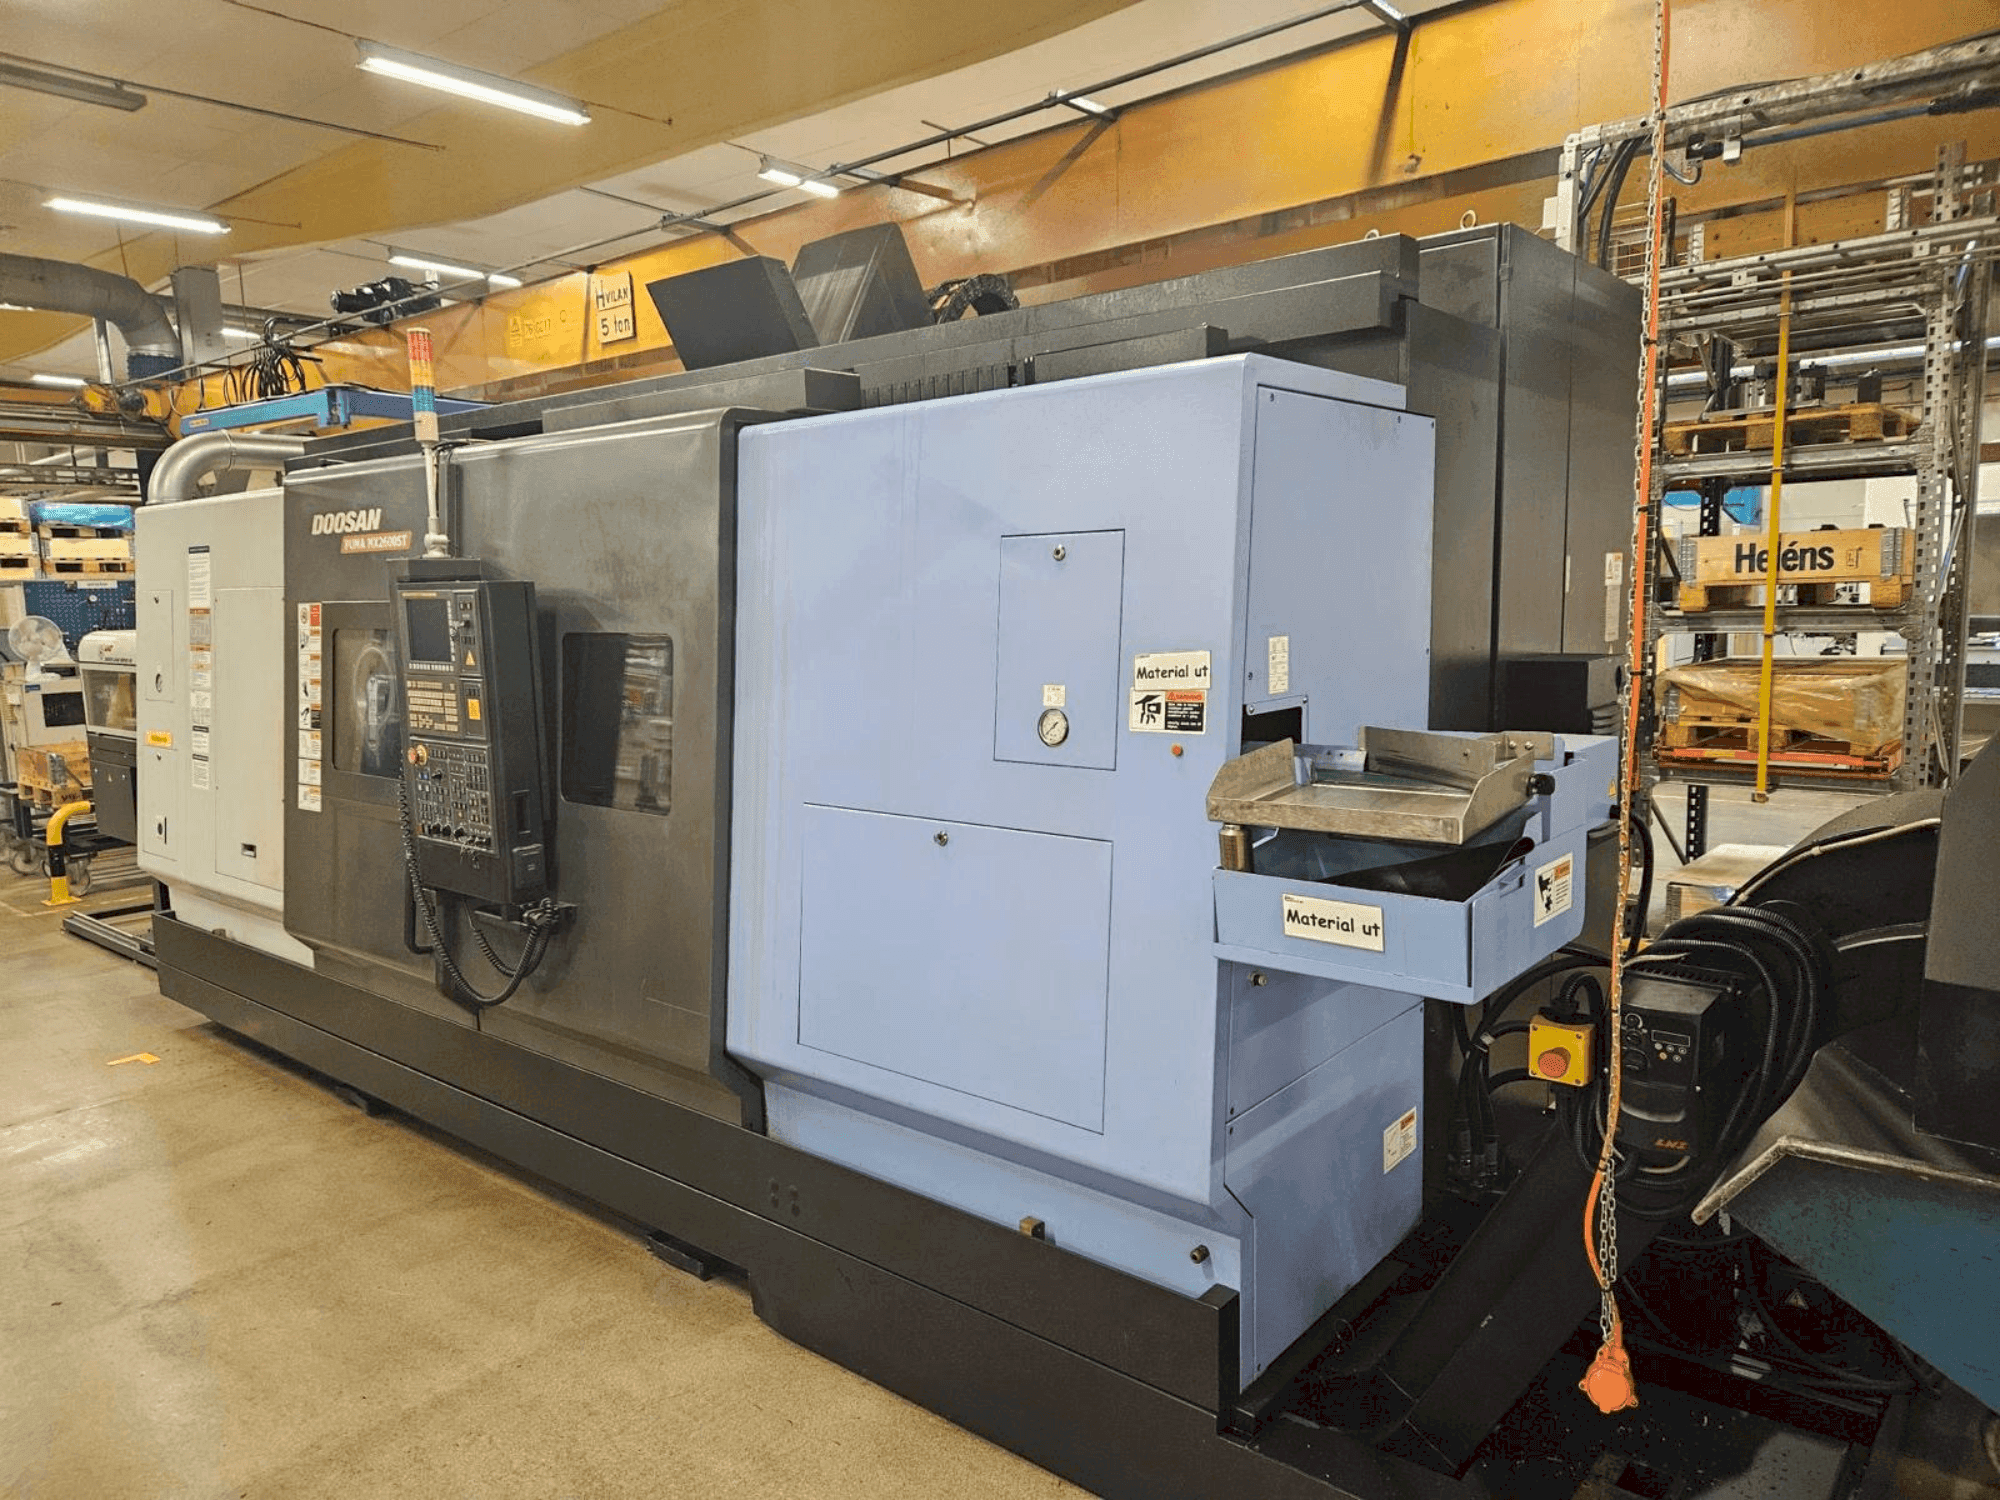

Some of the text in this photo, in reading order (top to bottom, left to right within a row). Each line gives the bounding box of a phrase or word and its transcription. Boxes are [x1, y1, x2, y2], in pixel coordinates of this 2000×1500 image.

[600, 314, 631, 336] 5 ton
[311, 508, 382, 535] DOOSAN
[1136, 664, 1209, 679] Material ut
[1286, 909, 1381, 937] Material ut
